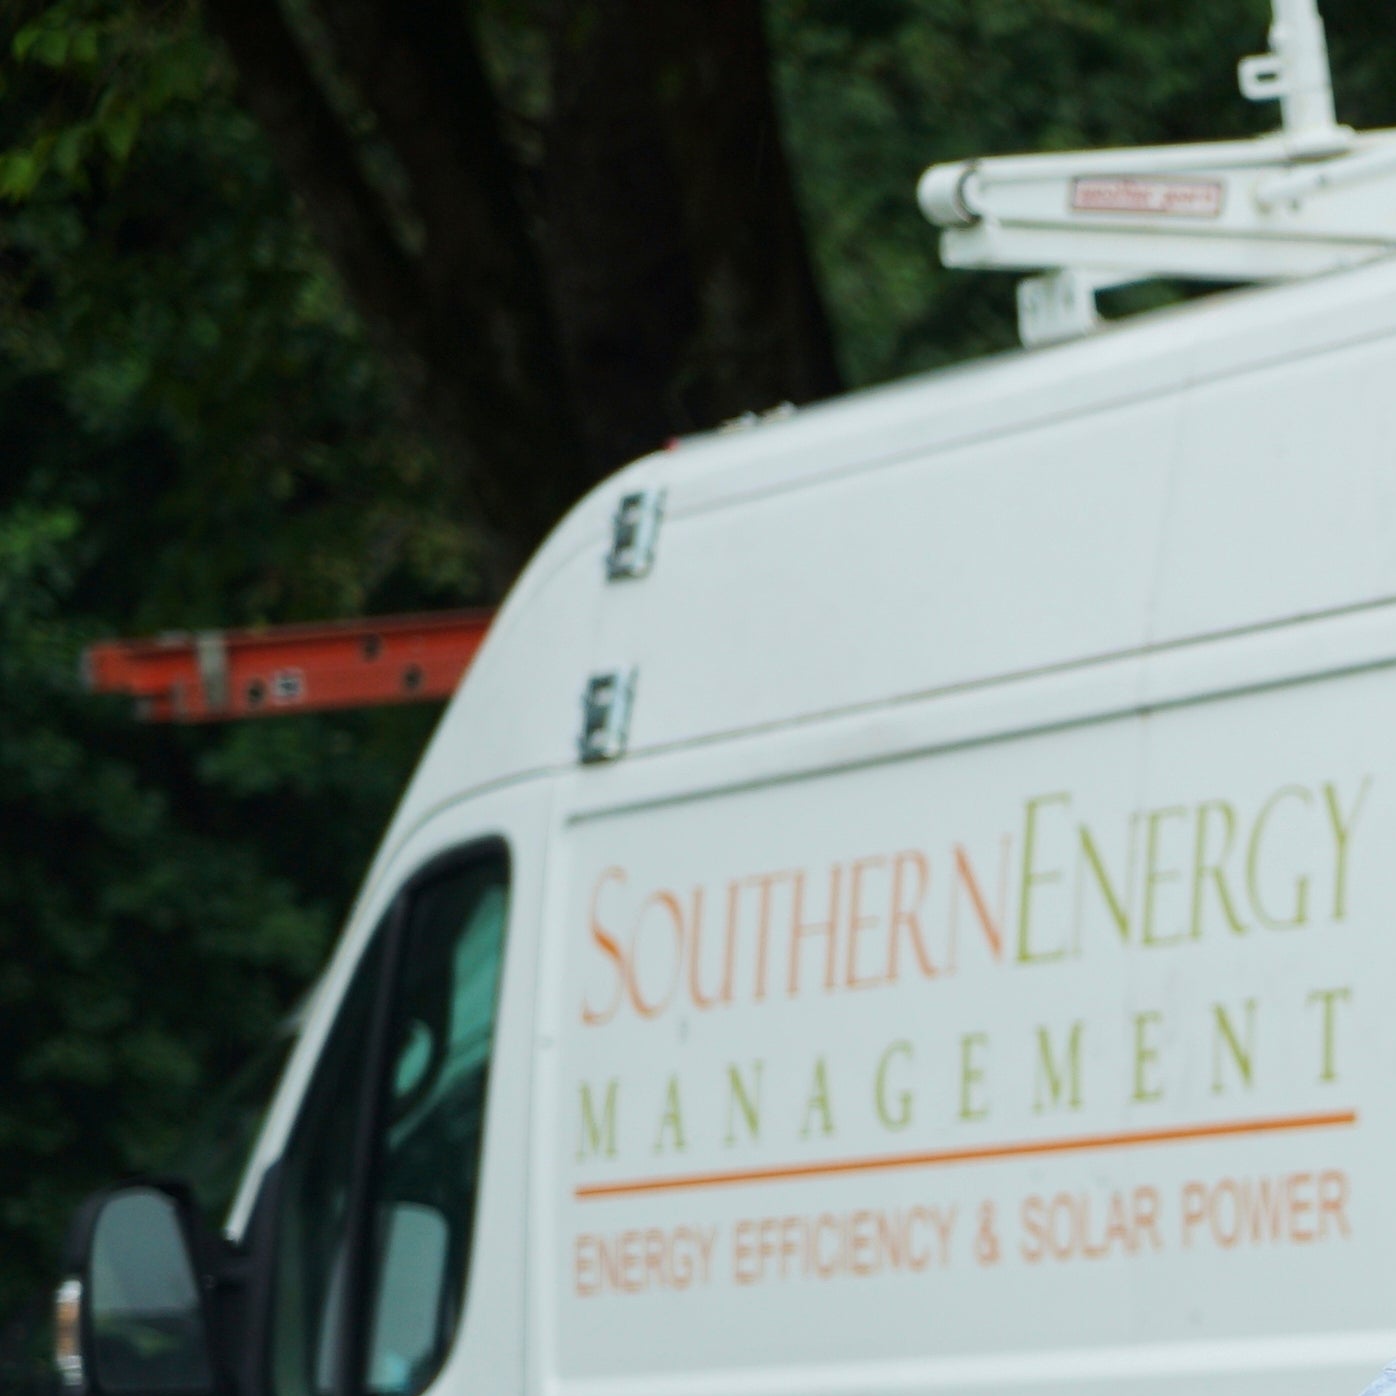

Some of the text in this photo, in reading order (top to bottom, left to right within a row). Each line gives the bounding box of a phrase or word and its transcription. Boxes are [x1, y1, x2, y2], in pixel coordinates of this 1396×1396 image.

[576, 988, 1352, 1162] MANAGEMENT
[573, 1170, 1352, 1298] ENERGY EFFICIENCY & SOLAR POWER
